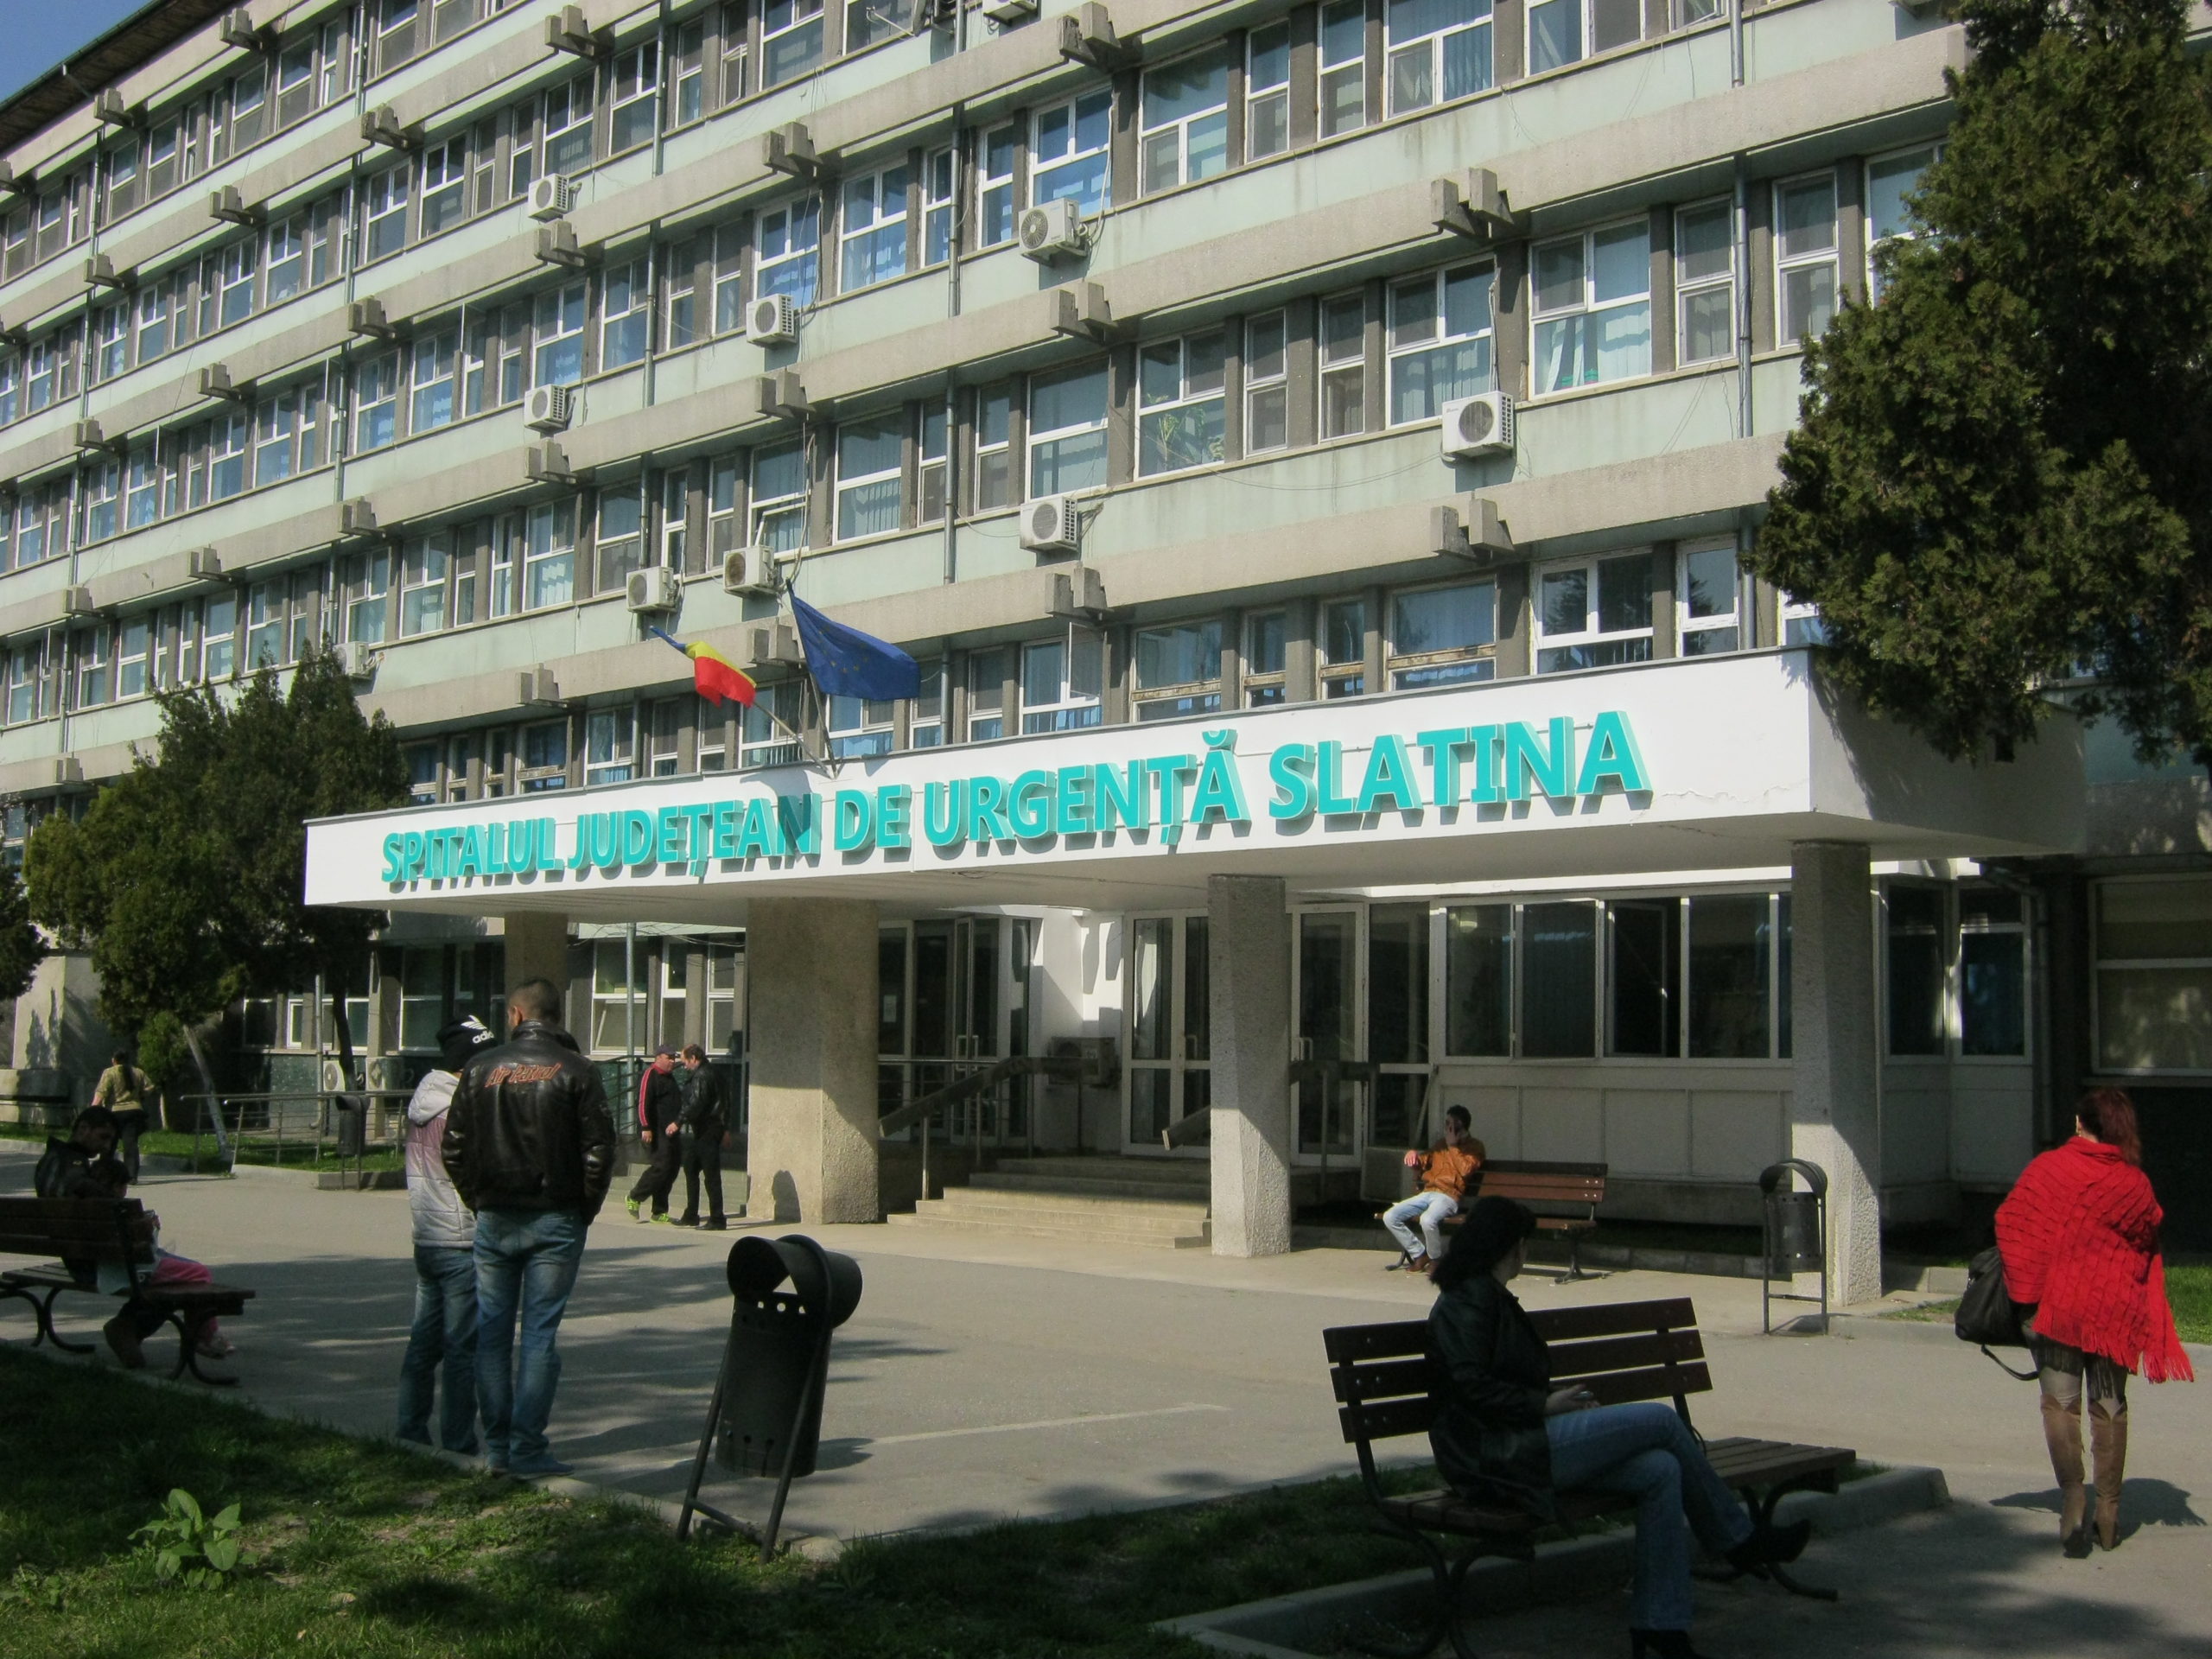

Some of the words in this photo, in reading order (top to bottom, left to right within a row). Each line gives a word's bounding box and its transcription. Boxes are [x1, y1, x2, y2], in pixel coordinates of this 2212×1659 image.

[381, 817, 565, 883] SPITALUL
[567, 792, 823, 877] JUDEȚEAN
[834, 784, 912, 851] DE
[924, 728, 1251, 847] URGENȚĂ
[1268, 710, 1653, 820] SLATINA
